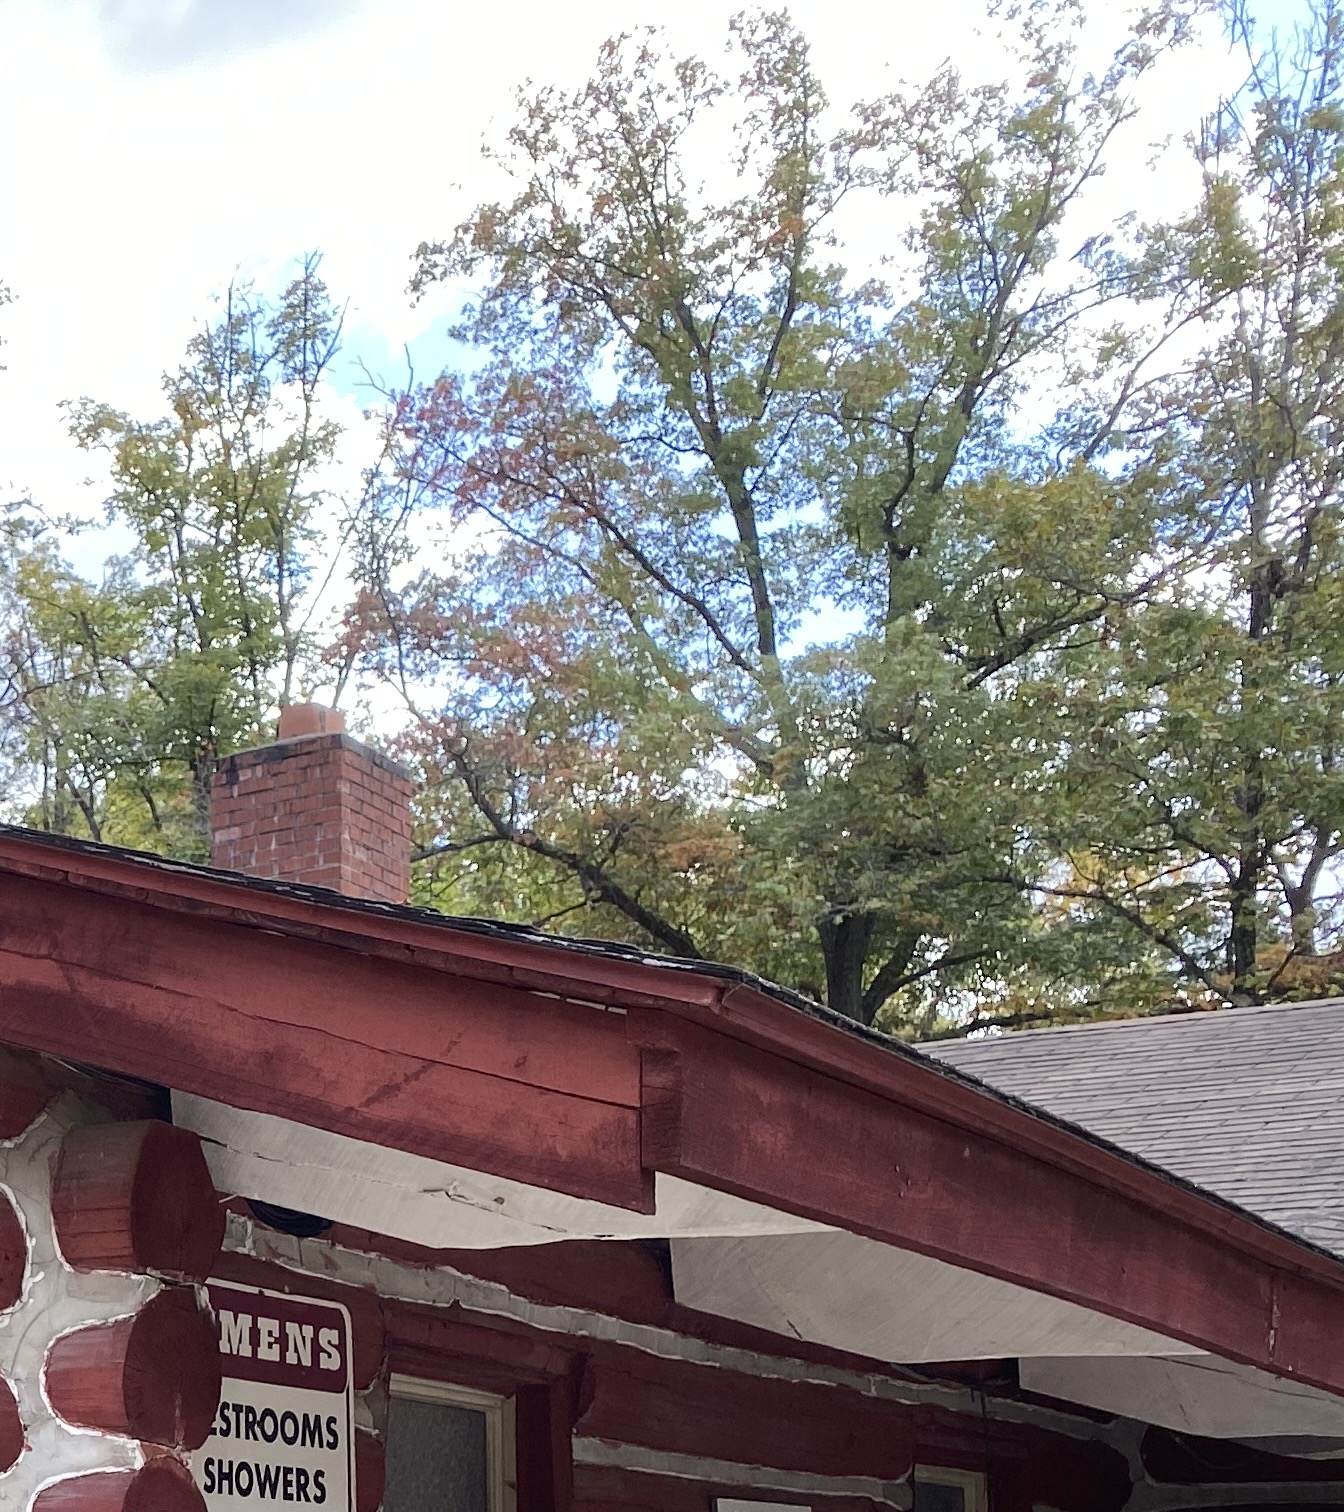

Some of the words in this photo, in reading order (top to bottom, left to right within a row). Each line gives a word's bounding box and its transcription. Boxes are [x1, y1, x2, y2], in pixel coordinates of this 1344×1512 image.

[218, 1309, 341, 1372] MENS
[210, 1400, 339, 1451] STROOMS
[203, 1456, 327, 1505] SHOWERS
